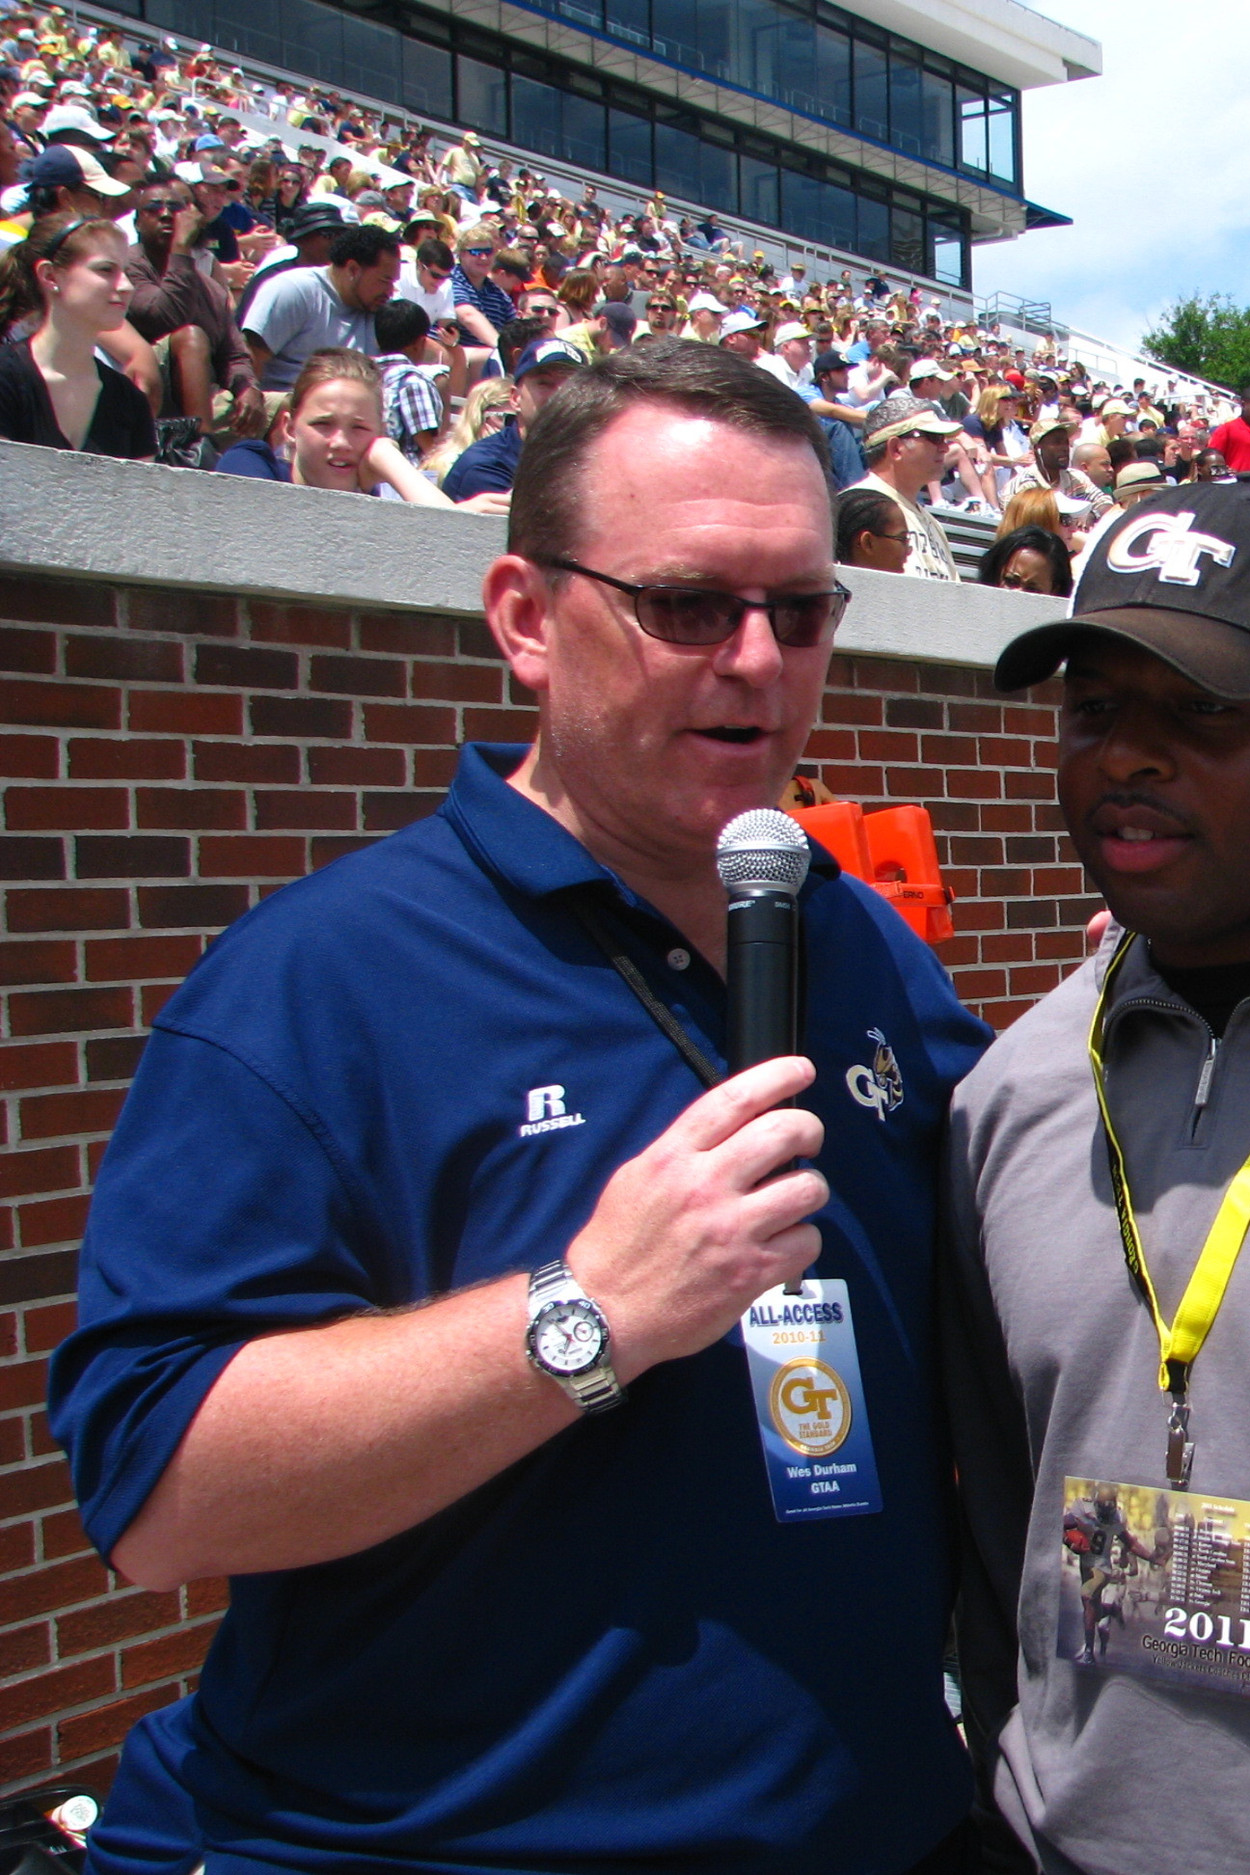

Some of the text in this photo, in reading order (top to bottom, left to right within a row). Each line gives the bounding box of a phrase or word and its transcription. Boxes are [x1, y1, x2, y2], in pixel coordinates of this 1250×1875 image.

[1107, 511, 1236, 587] GT
[528, 1084, 566, 1121] R
[520, 1113, 586, 1137] RUSSELL
[772, 1330, 826, 1345] 2010-11
[781, 1377, 838, 1420] GT
[787, 1463, 857, 1479] Wes Durham
[810, 1480, 840, 1494] GTAA
[1142, 1635, 1187, 1658] Georgia
[1191, 1644, 1223, 1663] Tech
